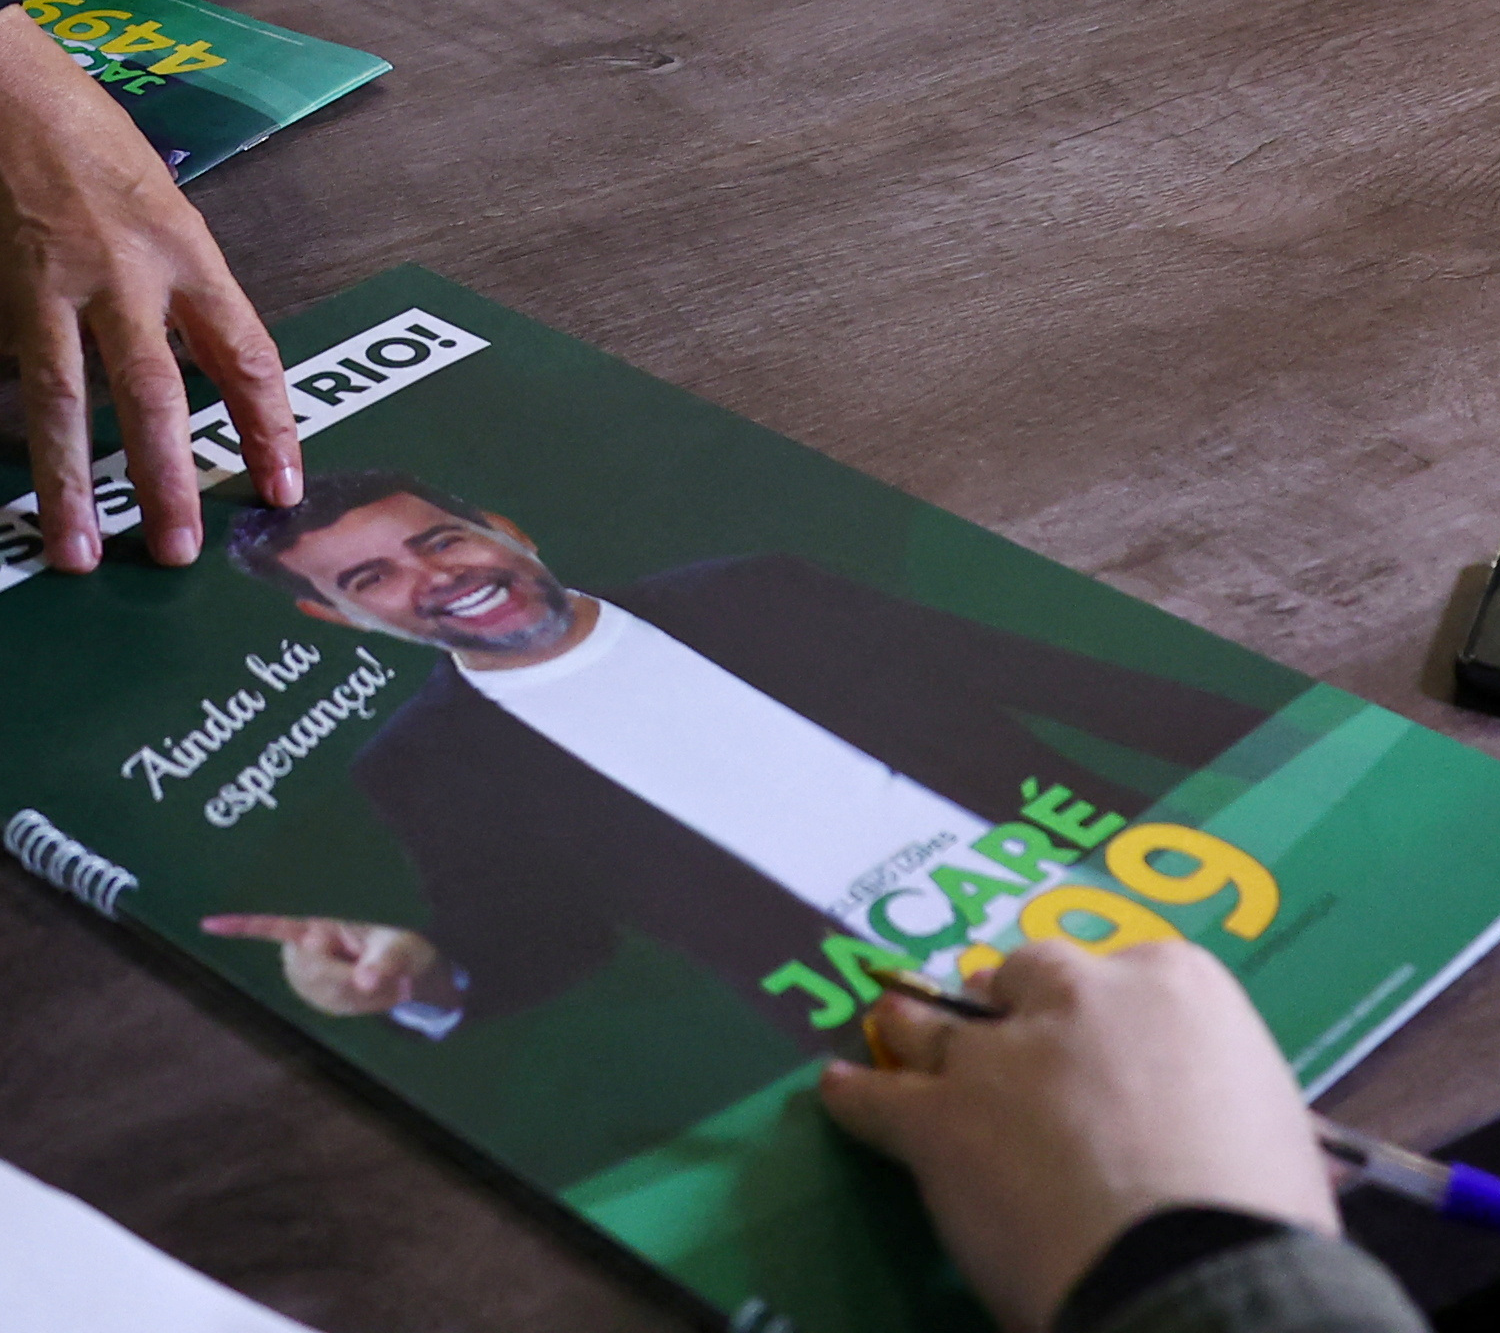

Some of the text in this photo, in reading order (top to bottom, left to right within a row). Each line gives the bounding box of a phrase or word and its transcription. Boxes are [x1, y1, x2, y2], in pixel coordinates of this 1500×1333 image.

[292, 323, 457, 406] RIO!
[120, 638, 322, 802] Ainda há
[204, 645, 396, 828] esperança!
[759, 775, 1128, 1030] JACARÉ
